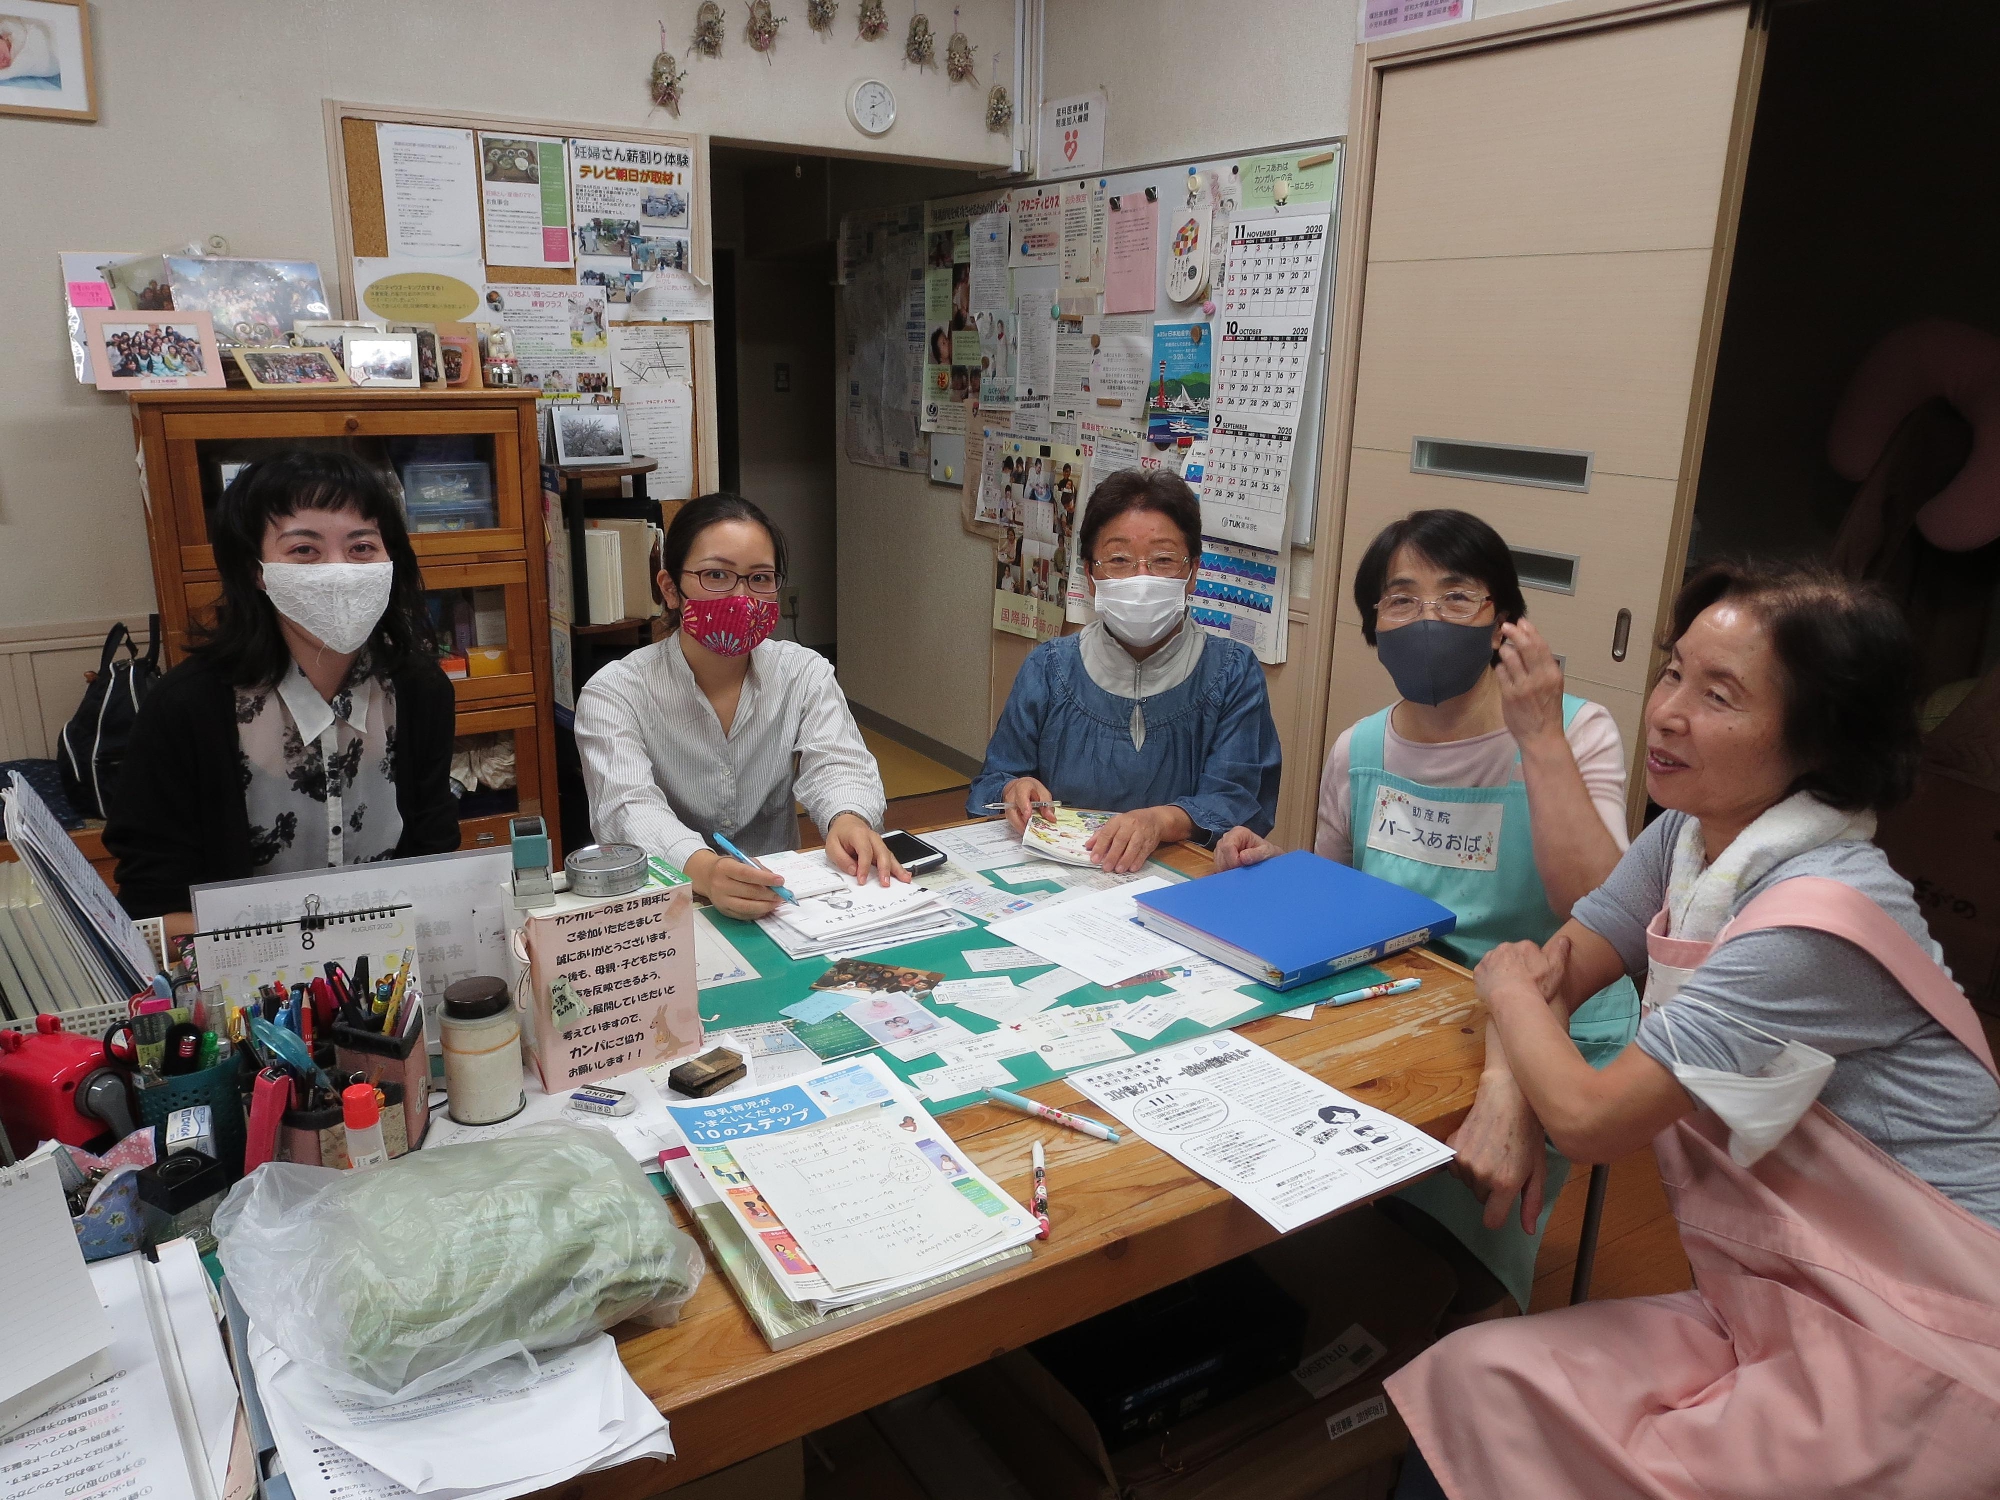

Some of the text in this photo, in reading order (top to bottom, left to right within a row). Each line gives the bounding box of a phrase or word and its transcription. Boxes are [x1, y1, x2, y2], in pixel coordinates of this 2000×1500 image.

[574, 145, 690, 168] 妊婦さん薪割り体験
[579, 165, 682, 186] テレビ朝日が取材！
[1235, 225, 1323, 238] 11 NOVEMBER 2020
[1227, 321, 1238, 335] 10
[1293, 327, 1308, 335] 2020
[1215, 414, 1222, 427] 9
[1223, 422, 1248, 430] SEPTEMBER
[1412, 807, 1451, 825] 助産院
[1378, 818, 1483, 852] バースあおば
[301, 922, 393, 950] 8 AUGUST 2020
[566, 912, 662, 943] ご参加いただきまして
[556, 930, 672, 966] 誠にありがとうございます。
[563, 1013, 642, 1041] 考えていますので、
[569, 1032, 645, 1059] カンパにご協力
[568, 1049, 642, 1078] お願いします！！
[584, 1089, 614, 1099] MONO
[694, 1103, 795, 1129] うまくいくための
[703, 1097, 771, 1118] 母乳育児が
[693, 1108, 809, 1141] 10のステップ
